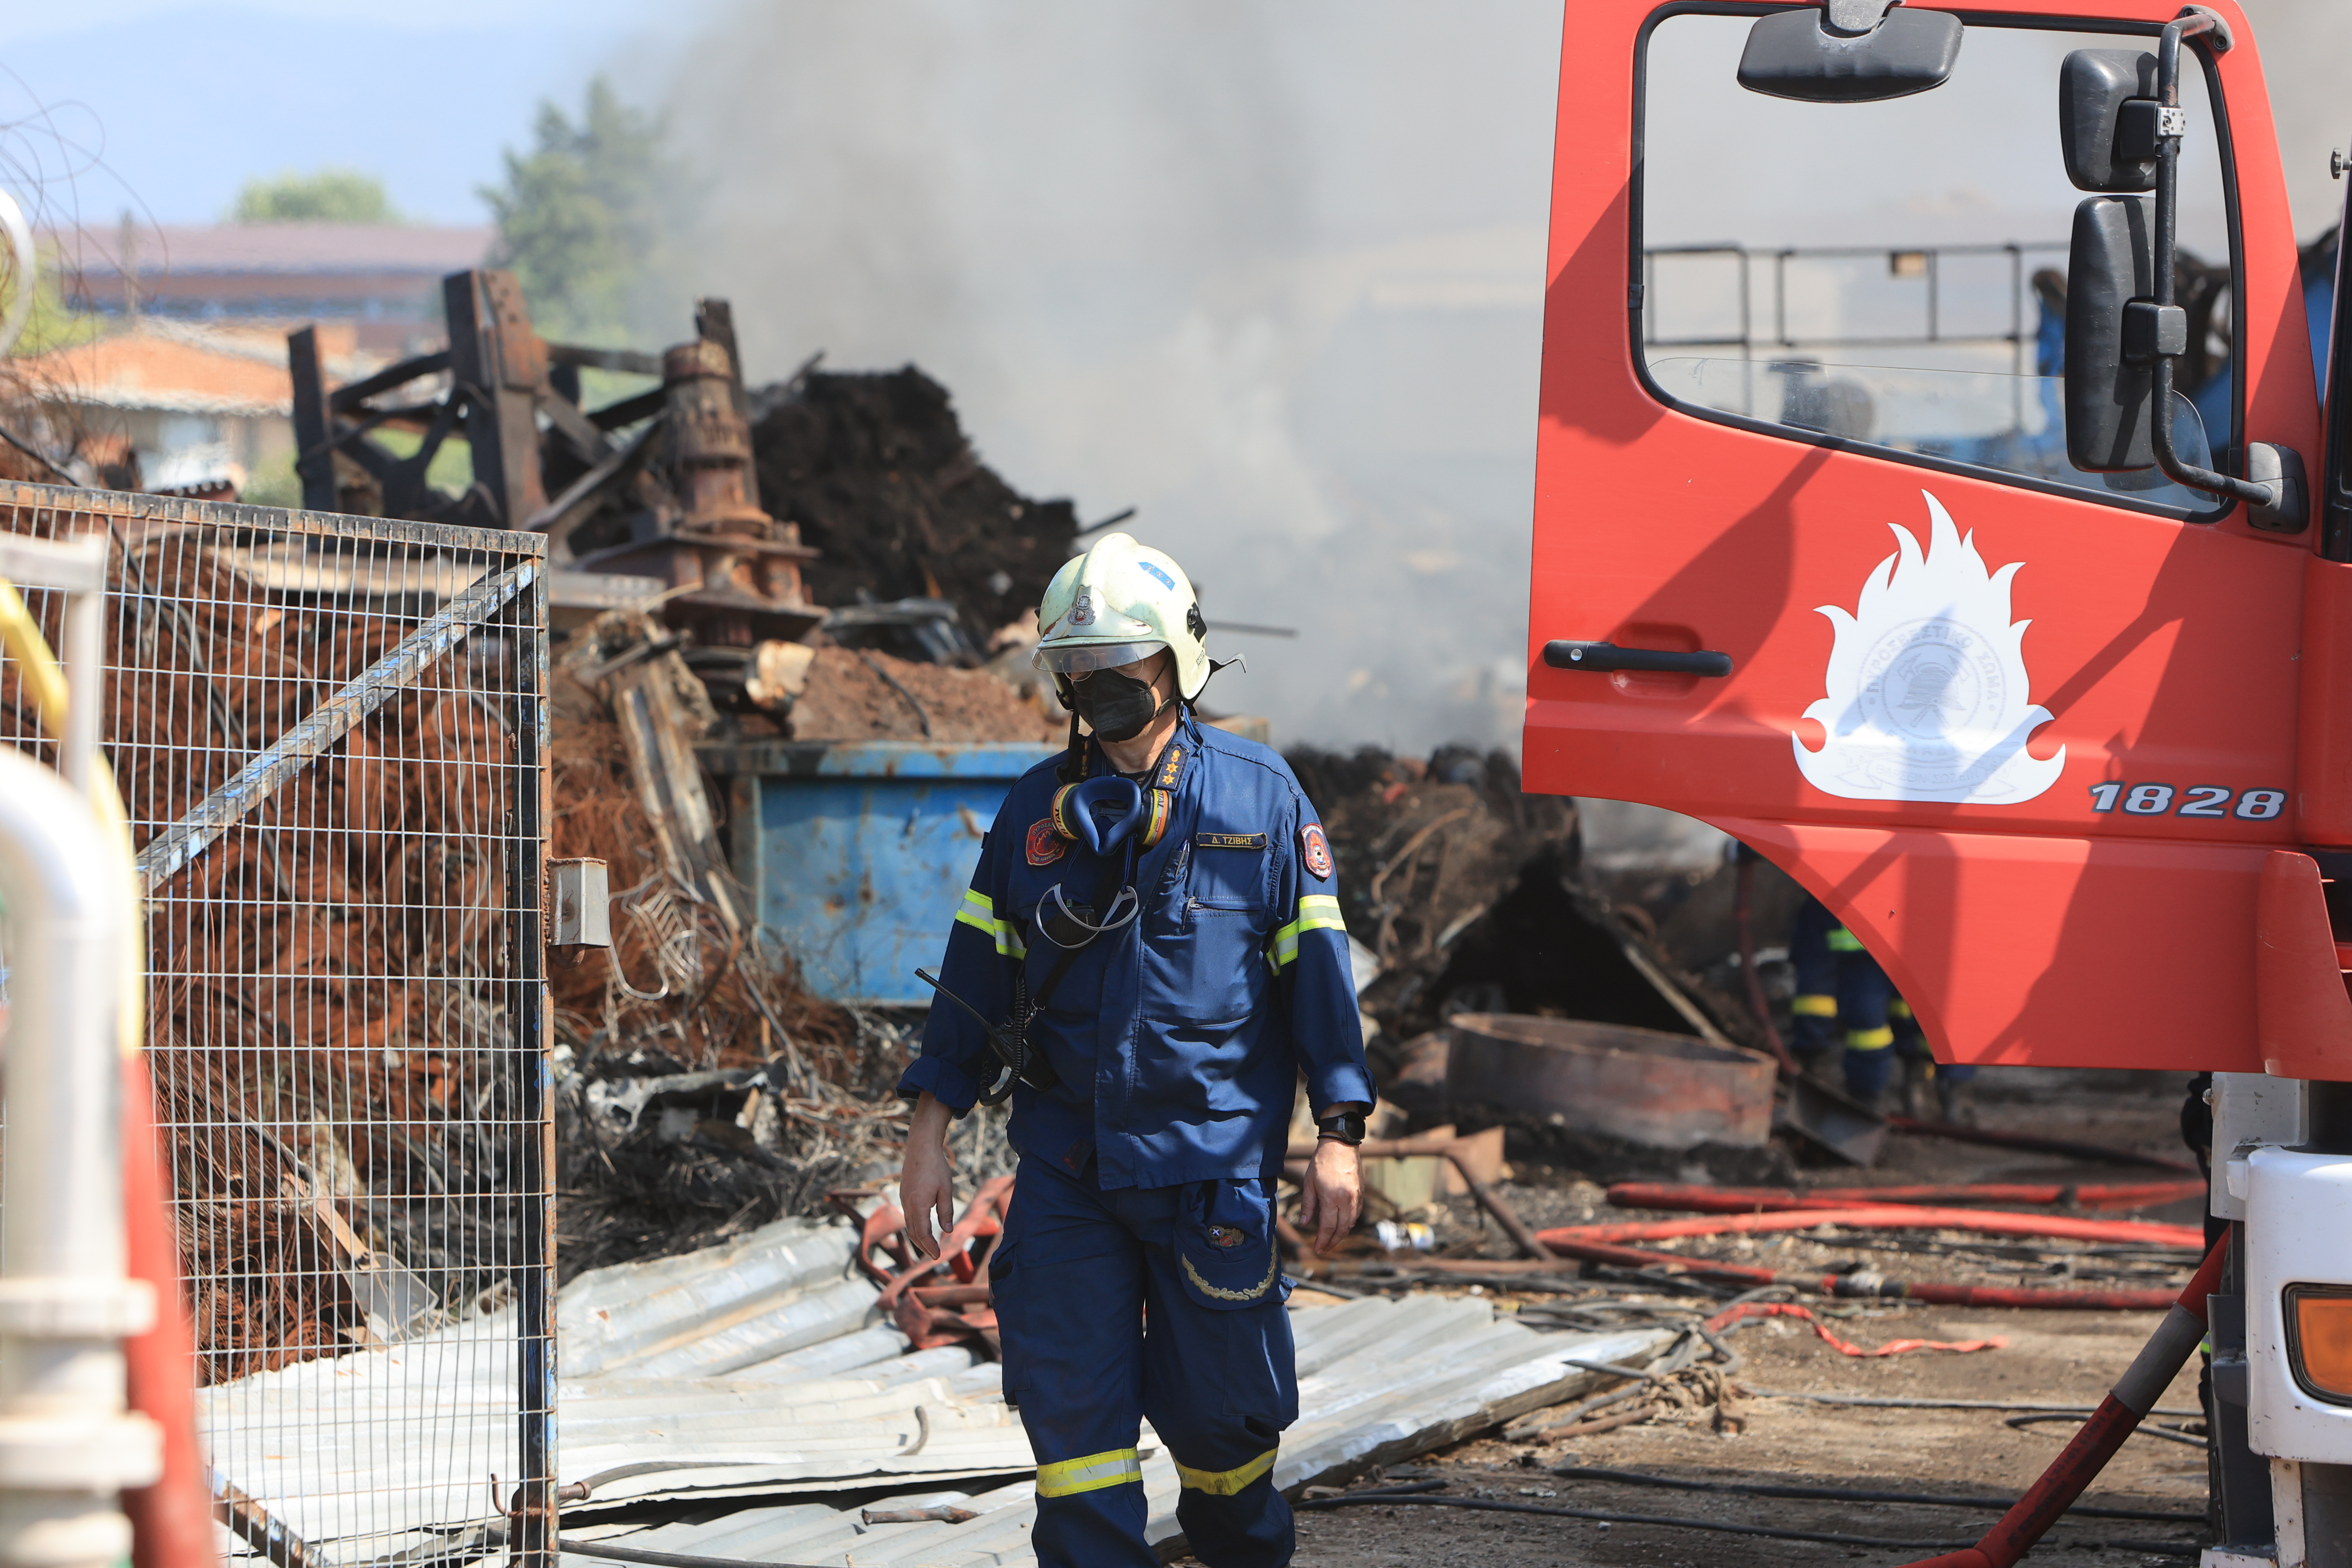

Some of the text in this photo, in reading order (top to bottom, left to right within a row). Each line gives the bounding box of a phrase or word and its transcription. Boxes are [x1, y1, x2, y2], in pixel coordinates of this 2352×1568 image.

[1976, 651, 2000, 700] ΣΩΜΑ
[2089, 781, 2288, 822] 1828
[1222, 836, 1252, 845] ΤΖΙΒΗΣ
